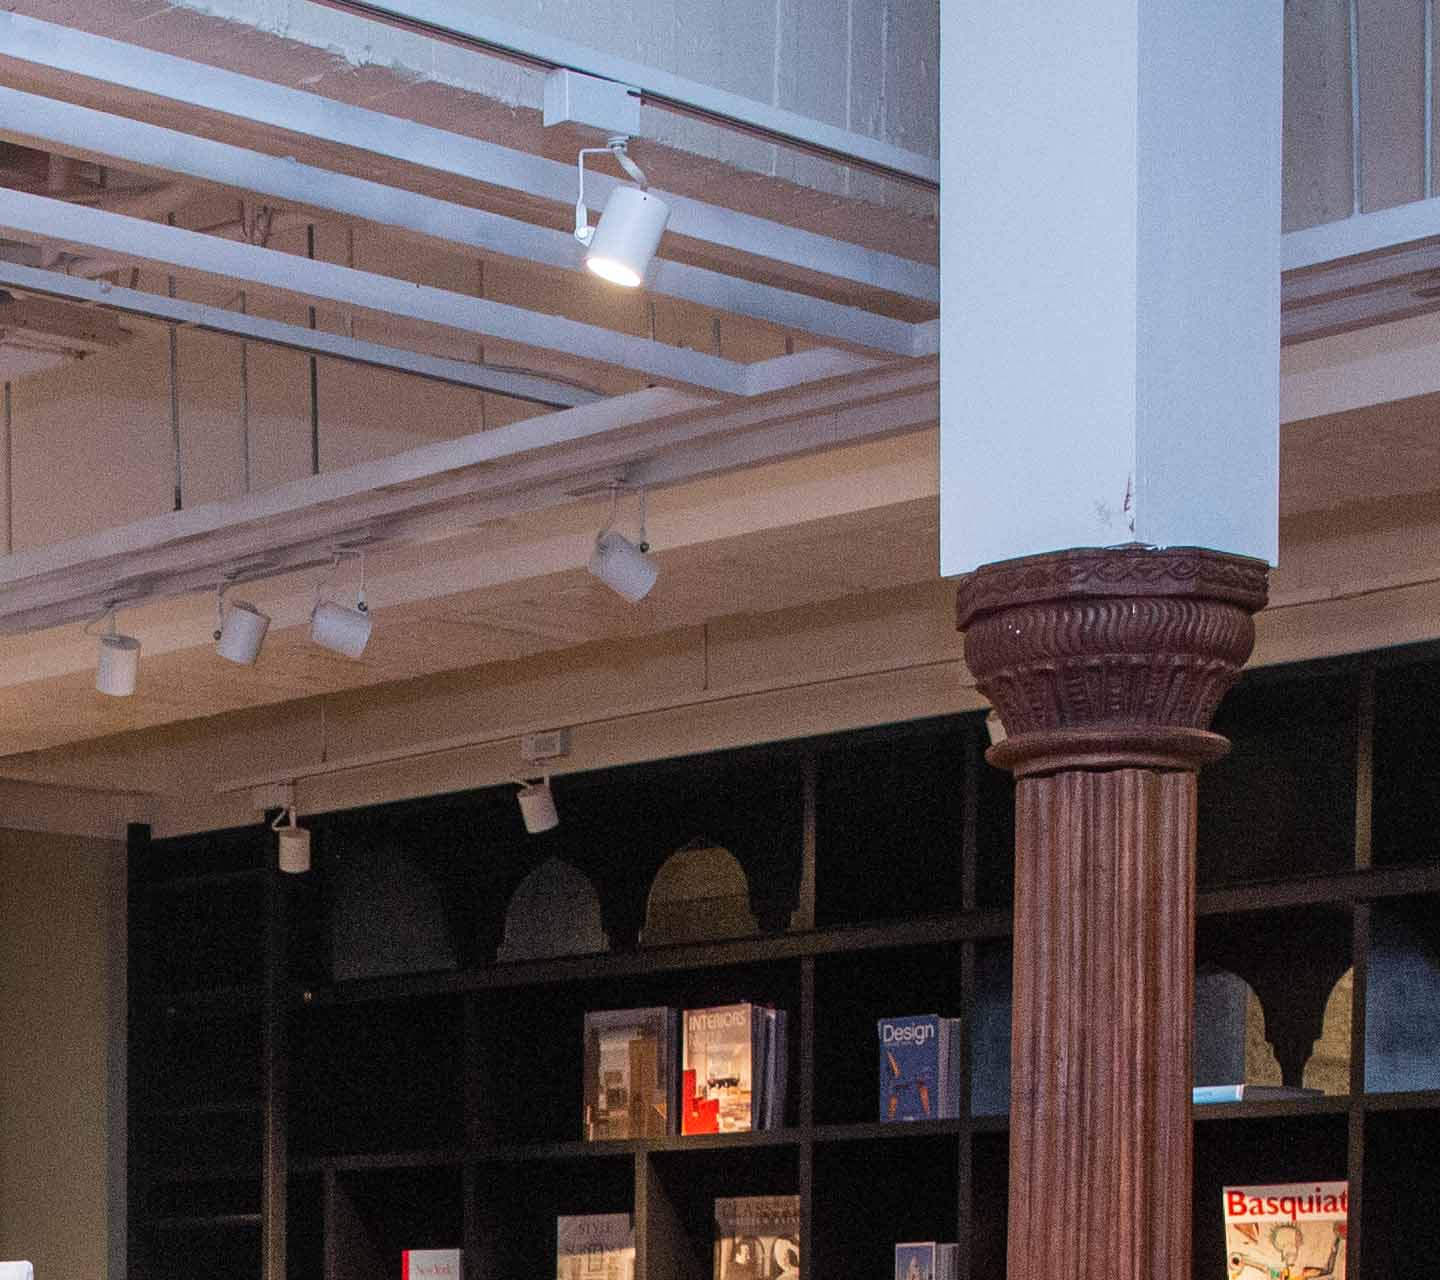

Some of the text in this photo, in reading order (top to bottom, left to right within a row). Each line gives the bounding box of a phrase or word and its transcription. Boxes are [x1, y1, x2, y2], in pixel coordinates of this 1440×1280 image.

[688, 1010, 747, 1031] INTERIORS
[883, 1023, 935, 1046] Design
[1226, 1186, 1348, 1221] Basquiat
